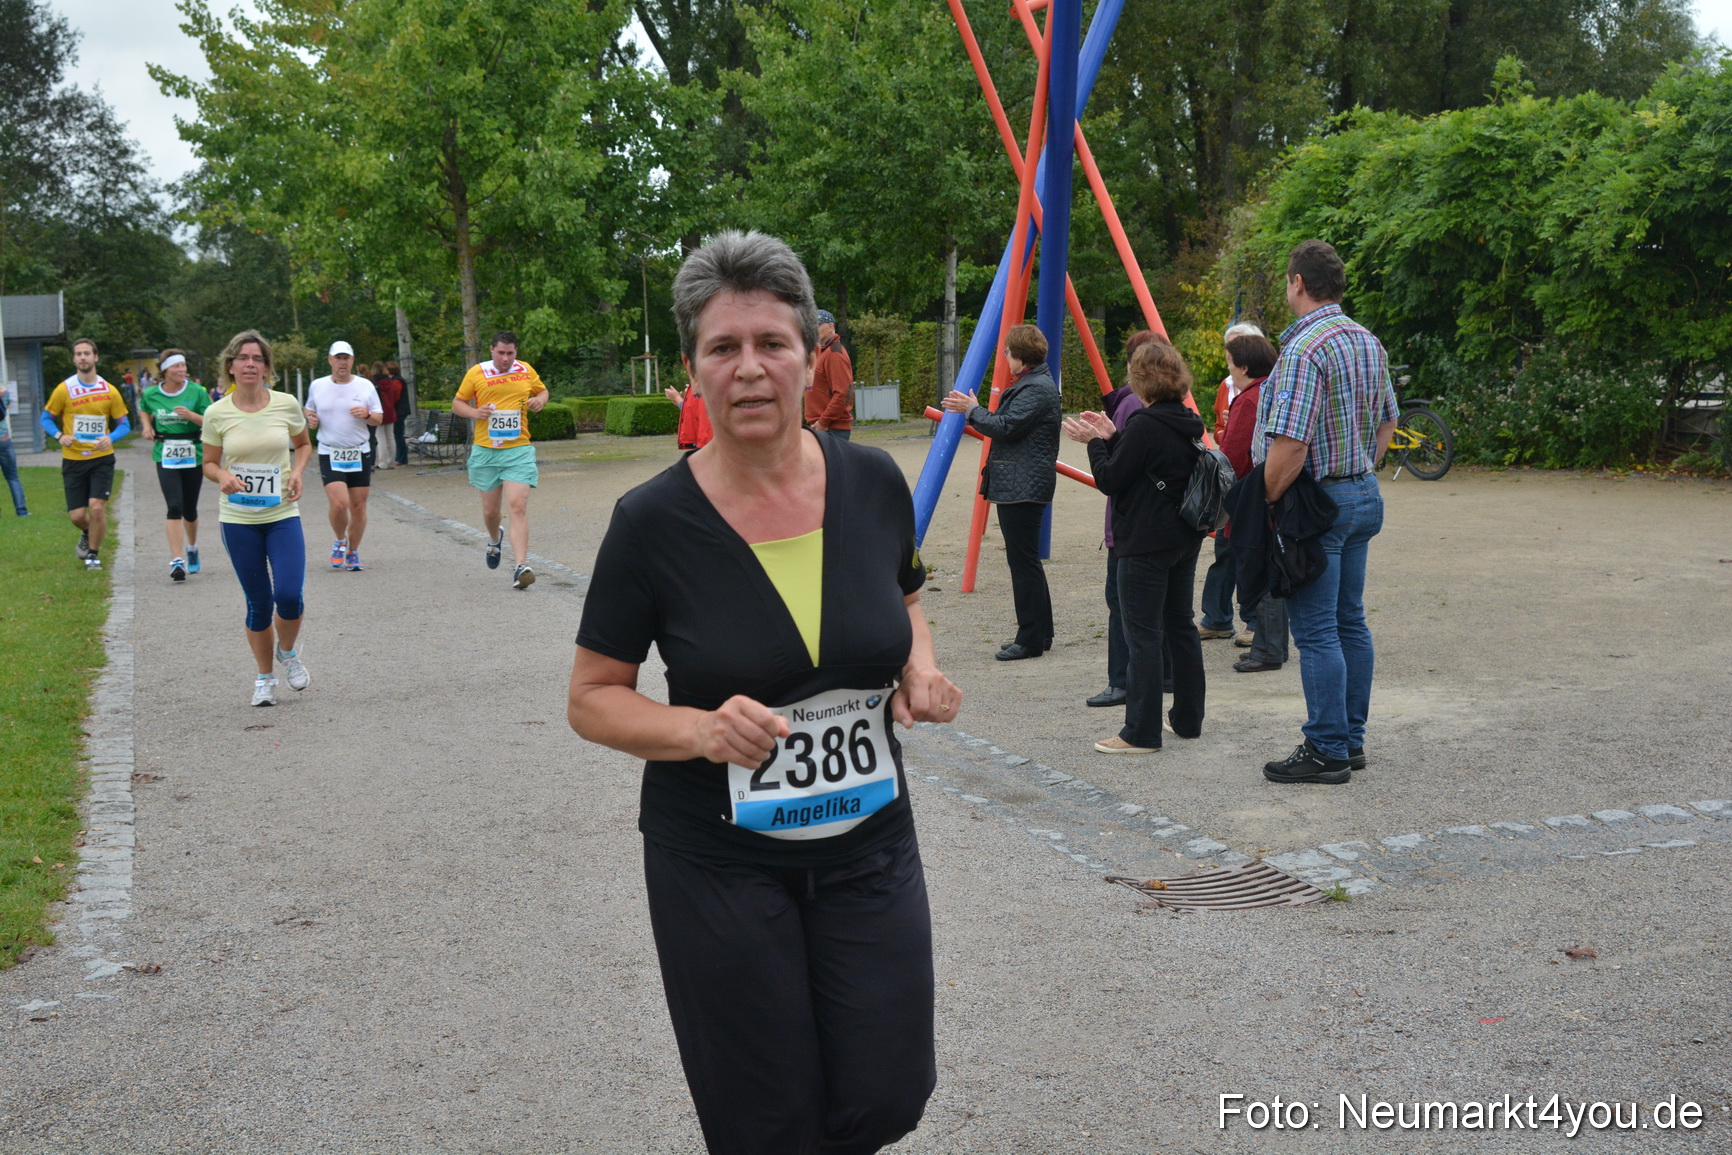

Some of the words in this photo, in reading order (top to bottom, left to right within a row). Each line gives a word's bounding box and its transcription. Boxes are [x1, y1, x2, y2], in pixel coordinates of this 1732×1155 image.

[487, 378, 508, 387] MAX
[72, 398, 91, 407] MAX
[77, 421, 104, 433] 2195
[491, 417, 519, 429] 2545
[165, 447, 192, 458] 2421
[333, 450, 359, 461] 2422
[241, 497, 266, 505] Sandra
[792, 698, 861, 722] Neumarkt
[749, 718, 878, 792] 2386
[737, 790, 745, 800] D
[770, 796, 862, 827] Angelika
